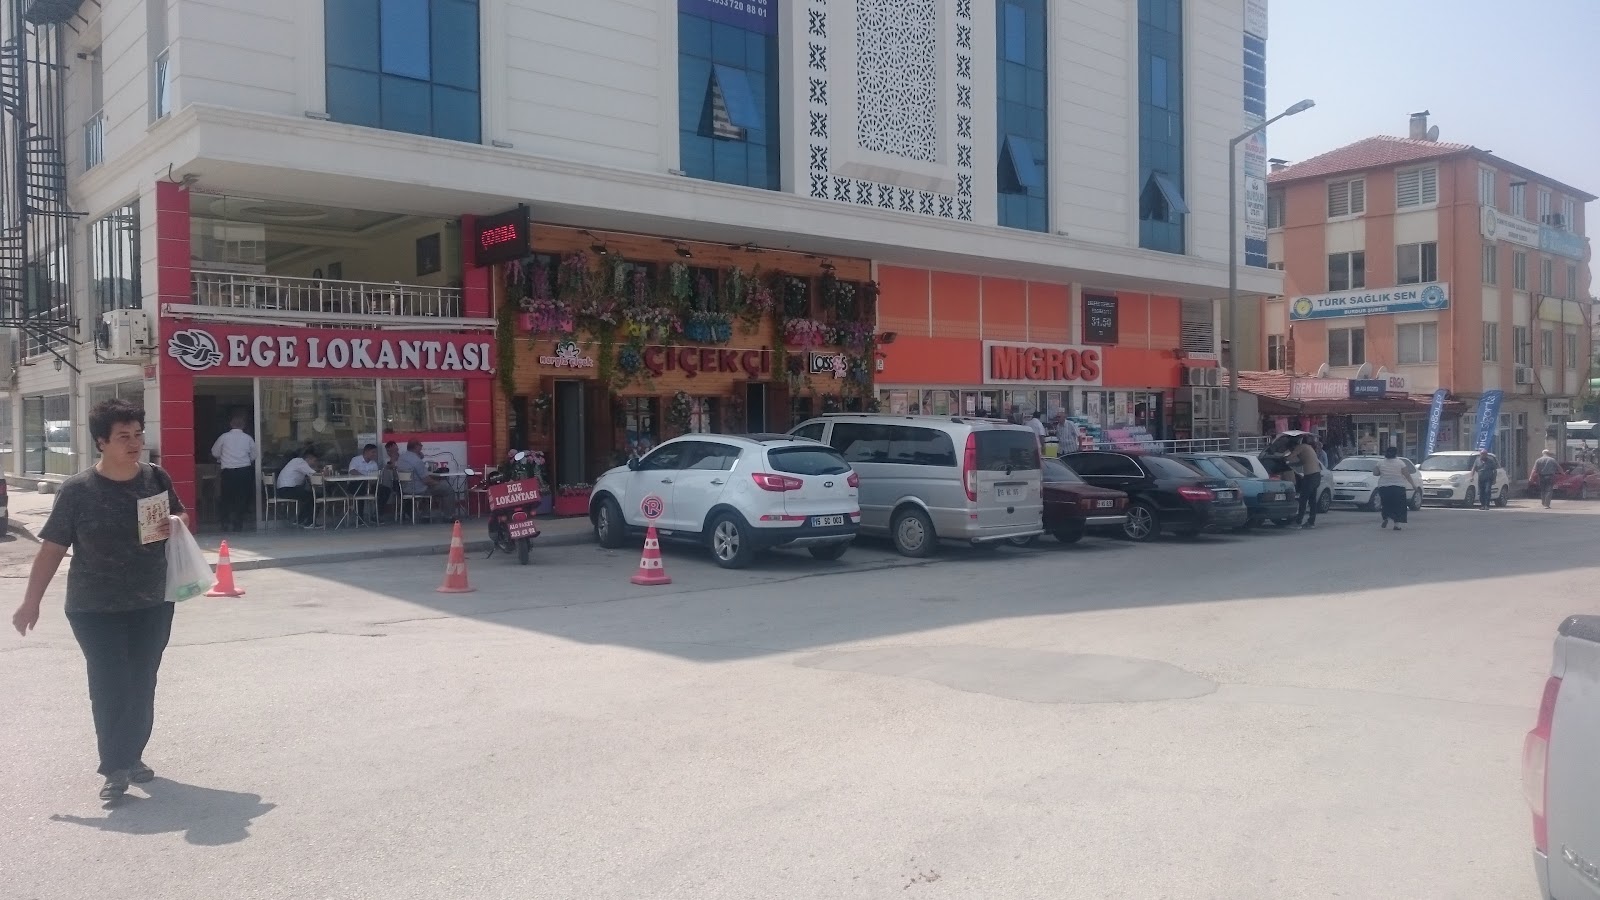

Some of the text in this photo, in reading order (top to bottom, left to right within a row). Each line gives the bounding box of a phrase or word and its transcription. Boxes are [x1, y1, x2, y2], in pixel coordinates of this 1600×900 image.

[746, 4, 756, 14] 88
[758, 7, 767, 17] 01
[481, 224, 517, 251] ÇORBA
[1317, 291, 1417, 308] TÜRK SAĞLIK SEN
[226, 334, 491, 371] EGE LOKANTASI
[1389, 376, 1405, 389] ERGO
[507, 483, 522, 493] EGE
[495, 491, 538, 505] LOKANTASI
